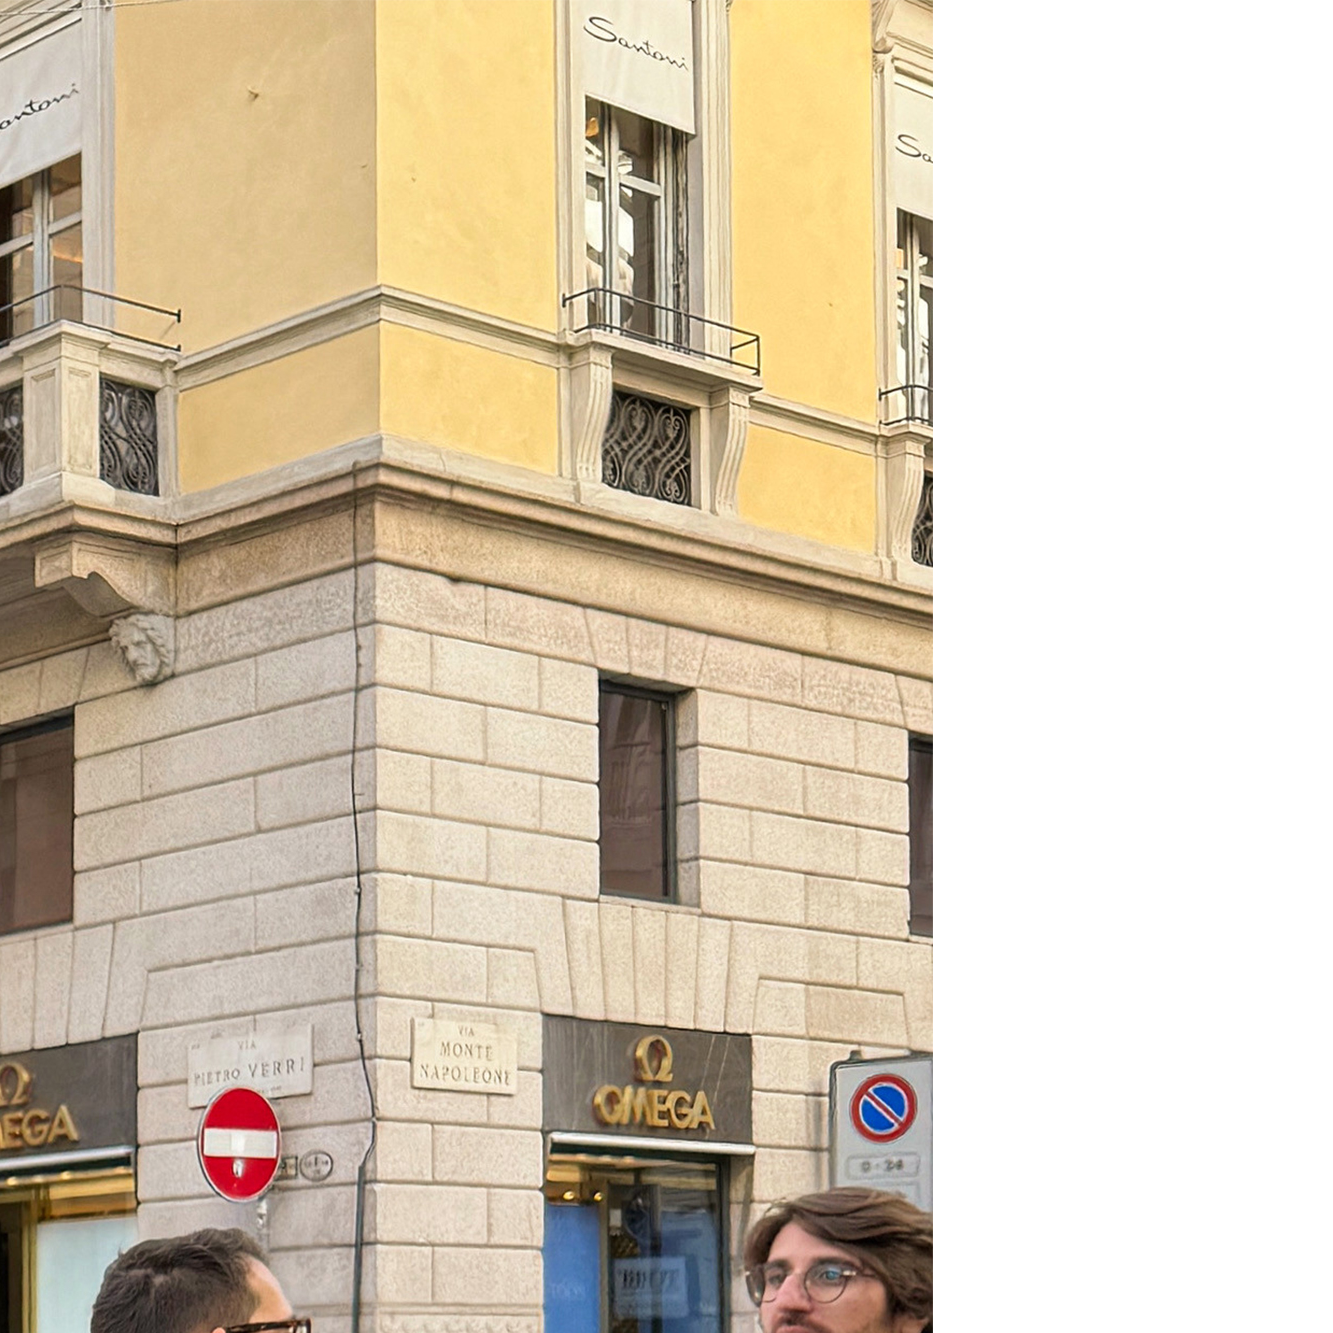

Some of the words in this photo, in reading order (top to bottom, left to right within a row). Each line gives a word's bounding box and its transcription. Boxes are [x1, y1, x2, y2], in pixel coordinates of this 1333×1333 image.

[582, 16, 689, 72] Santoni
[458, 1024, 475, 1037] VIA
[238, 1039, 257, 1051] VIA
[440, 1041, 493, 1061] MONTE
[194, 1068, 241, 1086] PIETRO
[248, 1056, 305, 1078] VERRI
[420, 1063, 511, 1086] NAPOLEONE
[593, 1084, 716, 1130] OMEGA
